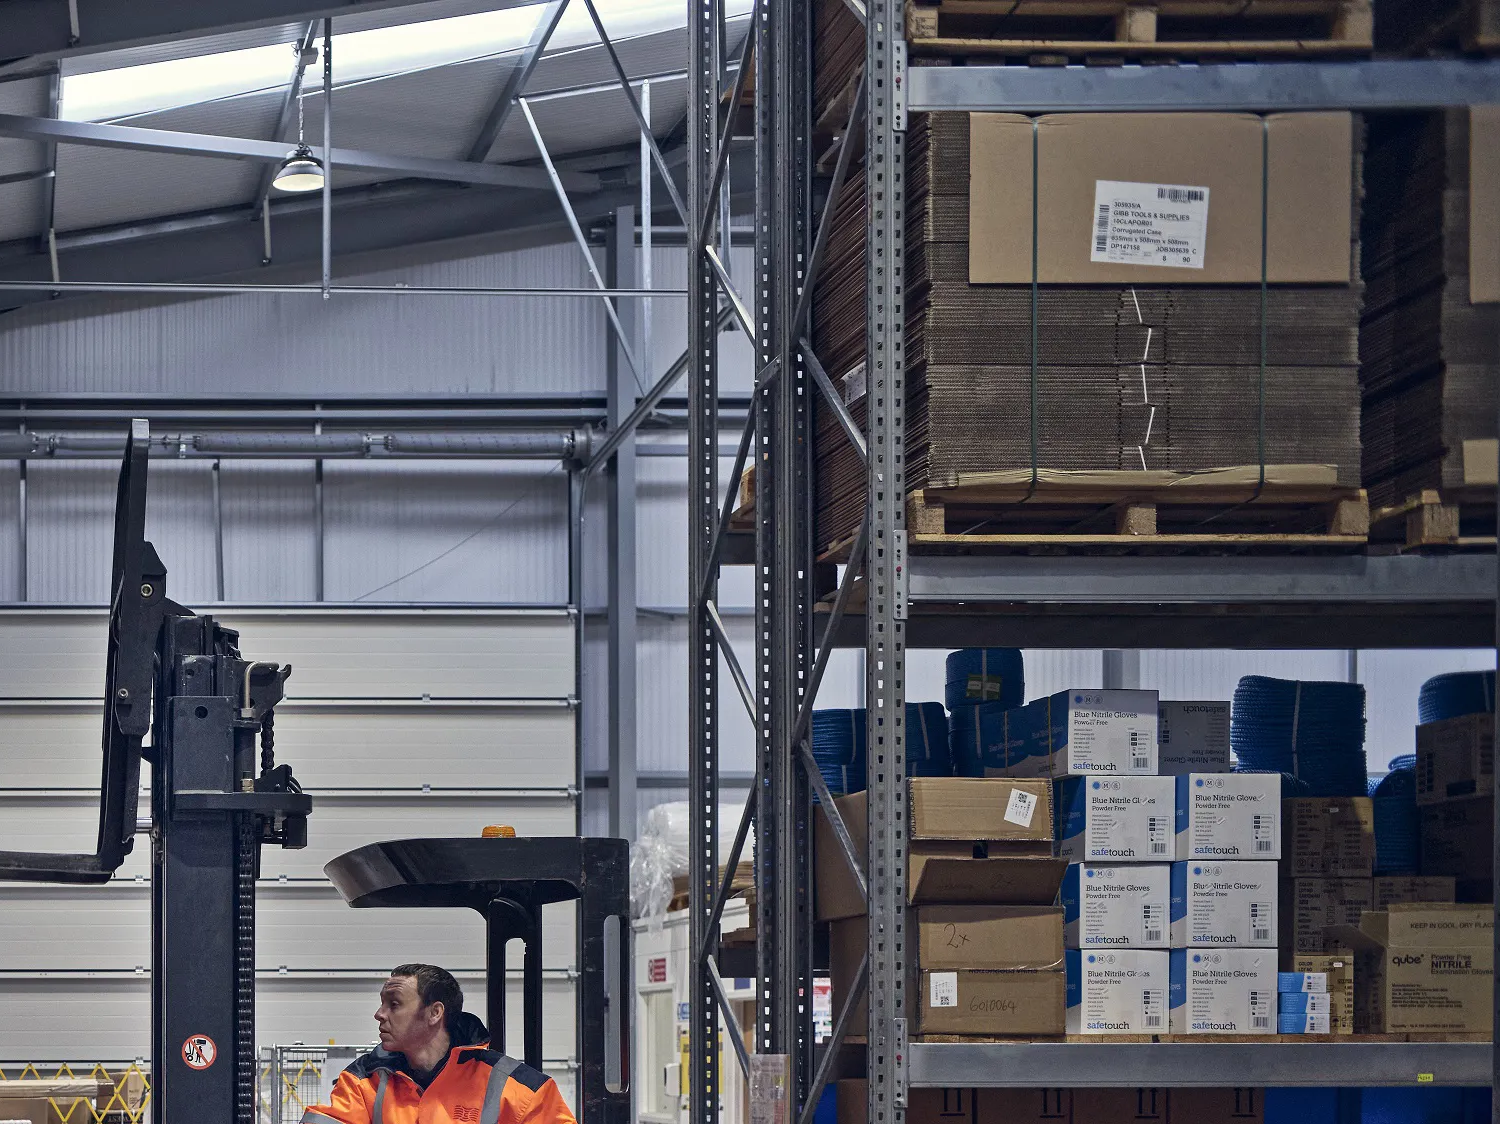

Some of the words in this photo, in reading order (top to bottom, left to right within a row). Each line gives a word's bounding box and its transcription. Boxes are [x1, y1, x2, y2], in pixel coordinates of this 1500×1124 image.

[1159, 213, 1190, 221] SUPPLIES
[1112, 227, 1146, 235] Corrugated
[1074, 711, 1090, 719] Blue
[1091, 711, 1114, 719] Nitrile
[1115, 711, 1138, 719] Gloves
[1073, 761, 1117, 771] safetouch
[1092, 796, 1108, 804] Blue
[1109, 796, 1131, 804] Nitrile
[1195, 794, 1211, 802] Blue
[1213, 794, 1235, 802] Nitrile
[1091, 847, 1135, 857] safetouch
[1195, 845, 1239, 855] safetouch
[1086, 884, 1102, 892] Blue
[1103, 884, 1125, 892] Nitrile
[1126, 884, 1150, 892] Gloves
[944, 923, 970, 949] 2x
[1085, 935, 1130, 945] safetouch
[1192, 934, 1237, 943] safetouch
[1392, 955, 1421, 967] qube
[1431, 961, 1472, 969] NITRILE
[1192, 970, 1208, 979] Blue
[1209, 970, 1232, 979] Nitrile
[1233, 970, 1258, 979] Gloves
[970, 1000, 1017, 1013] 6010064
[1087, 1021, 1130, 1030] safetouch
[1192, 1021, 1237, 1031] safetouch
